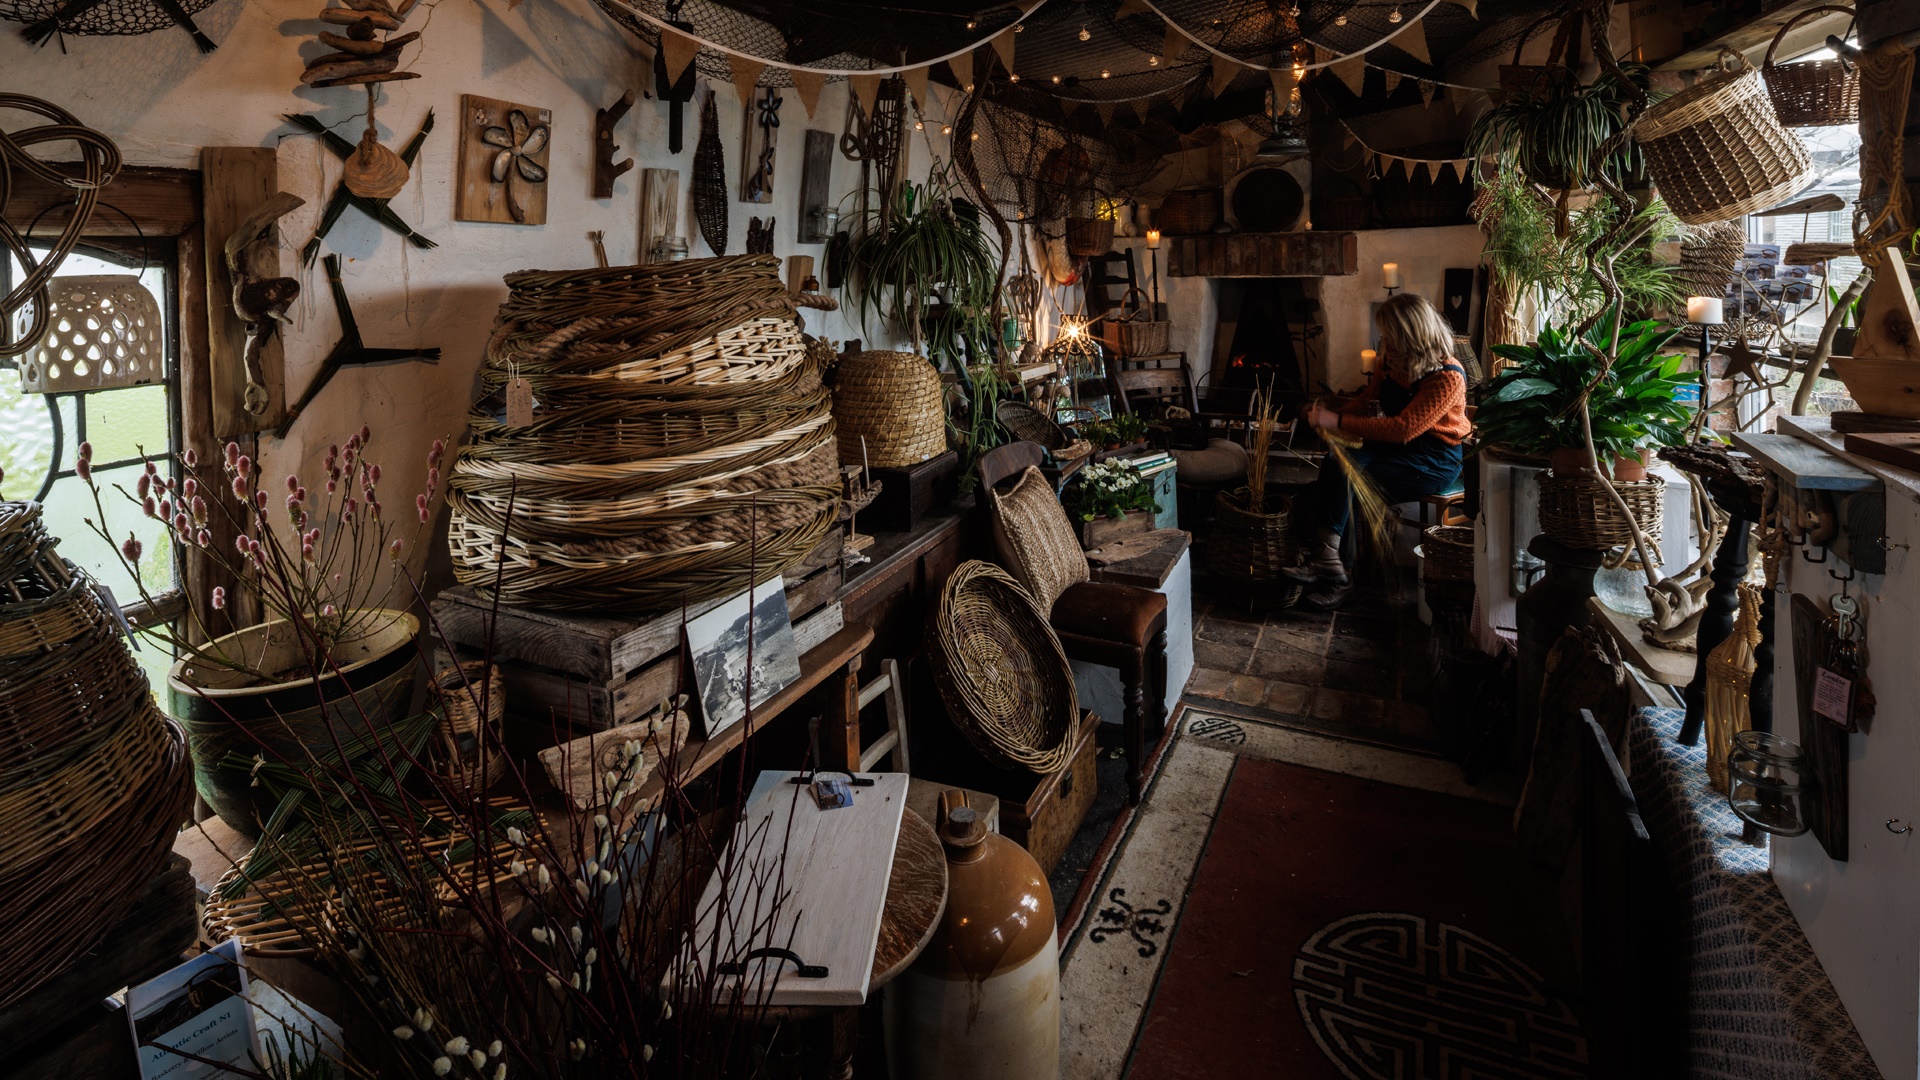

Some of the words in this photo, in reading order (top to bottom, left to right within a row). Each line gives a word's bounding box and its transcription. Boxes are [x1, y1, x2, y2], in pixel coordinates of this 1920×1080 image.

[1821, 671, 1846, 686] Louise
[151, 1036, 192, 1063] Atlntic
[193, 1020, 217, 1038] Craft
[219, 1011, 231, 1024] NI
[216, 1028, 238, 1045] Artists
